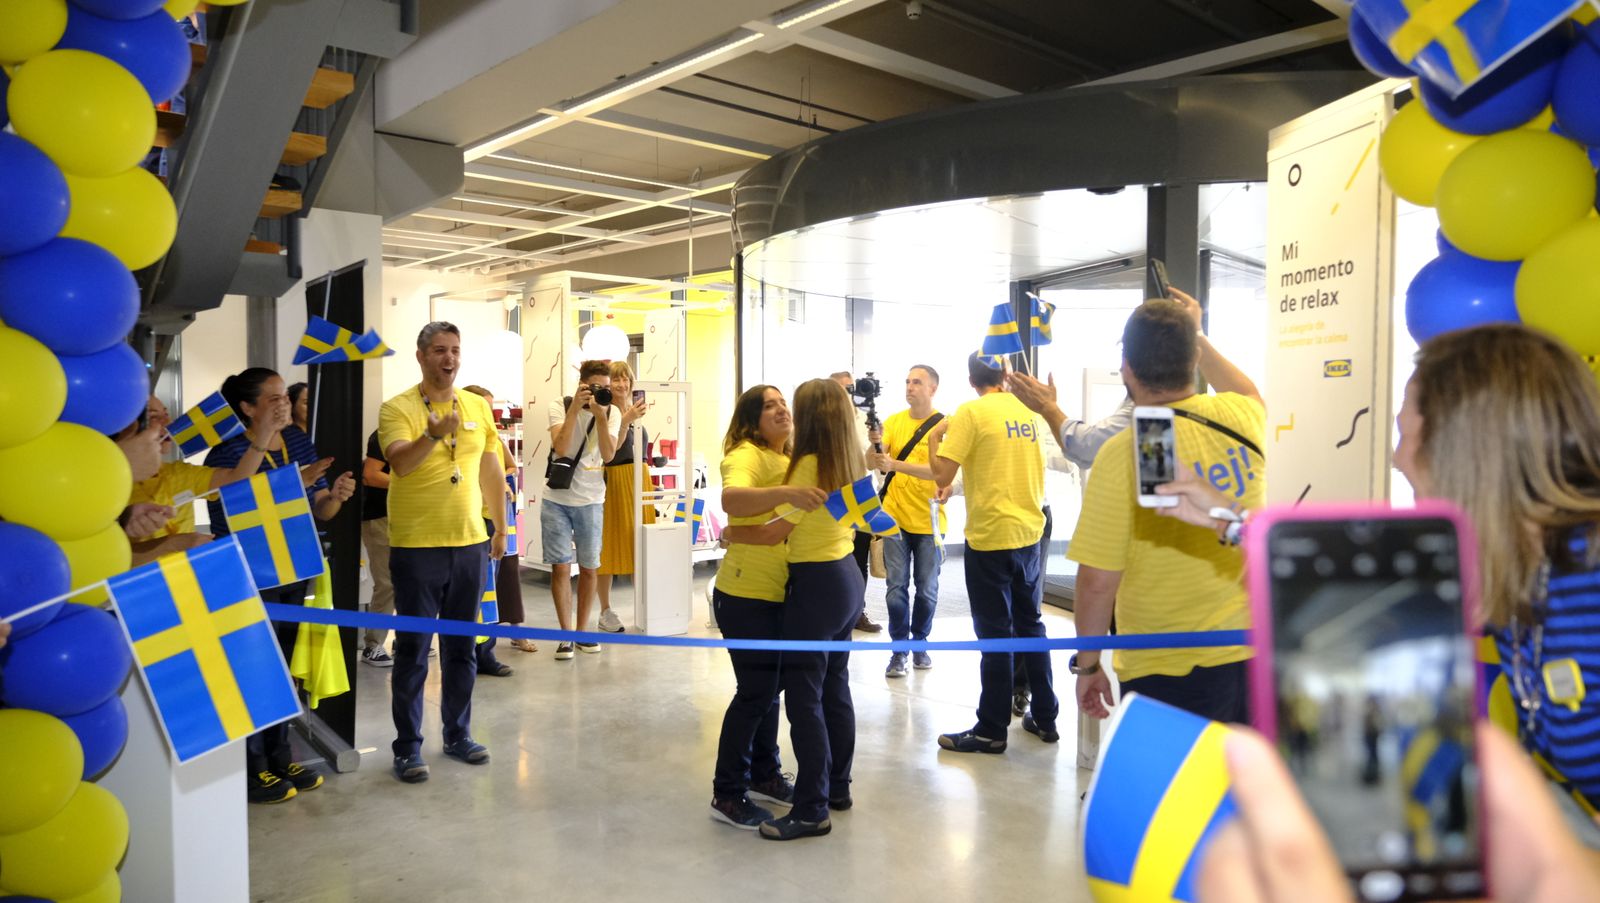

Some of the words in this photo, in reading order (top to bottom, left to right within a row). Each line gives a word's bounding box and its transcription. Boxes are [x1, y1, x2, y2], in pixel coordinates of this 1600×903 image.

[1282, 241, 1298, 262] Mi
[1281, 259, 1354, 288] momento
[1280, 294, 1297, 313] de
[1301, 288, 1339, 311] relax
